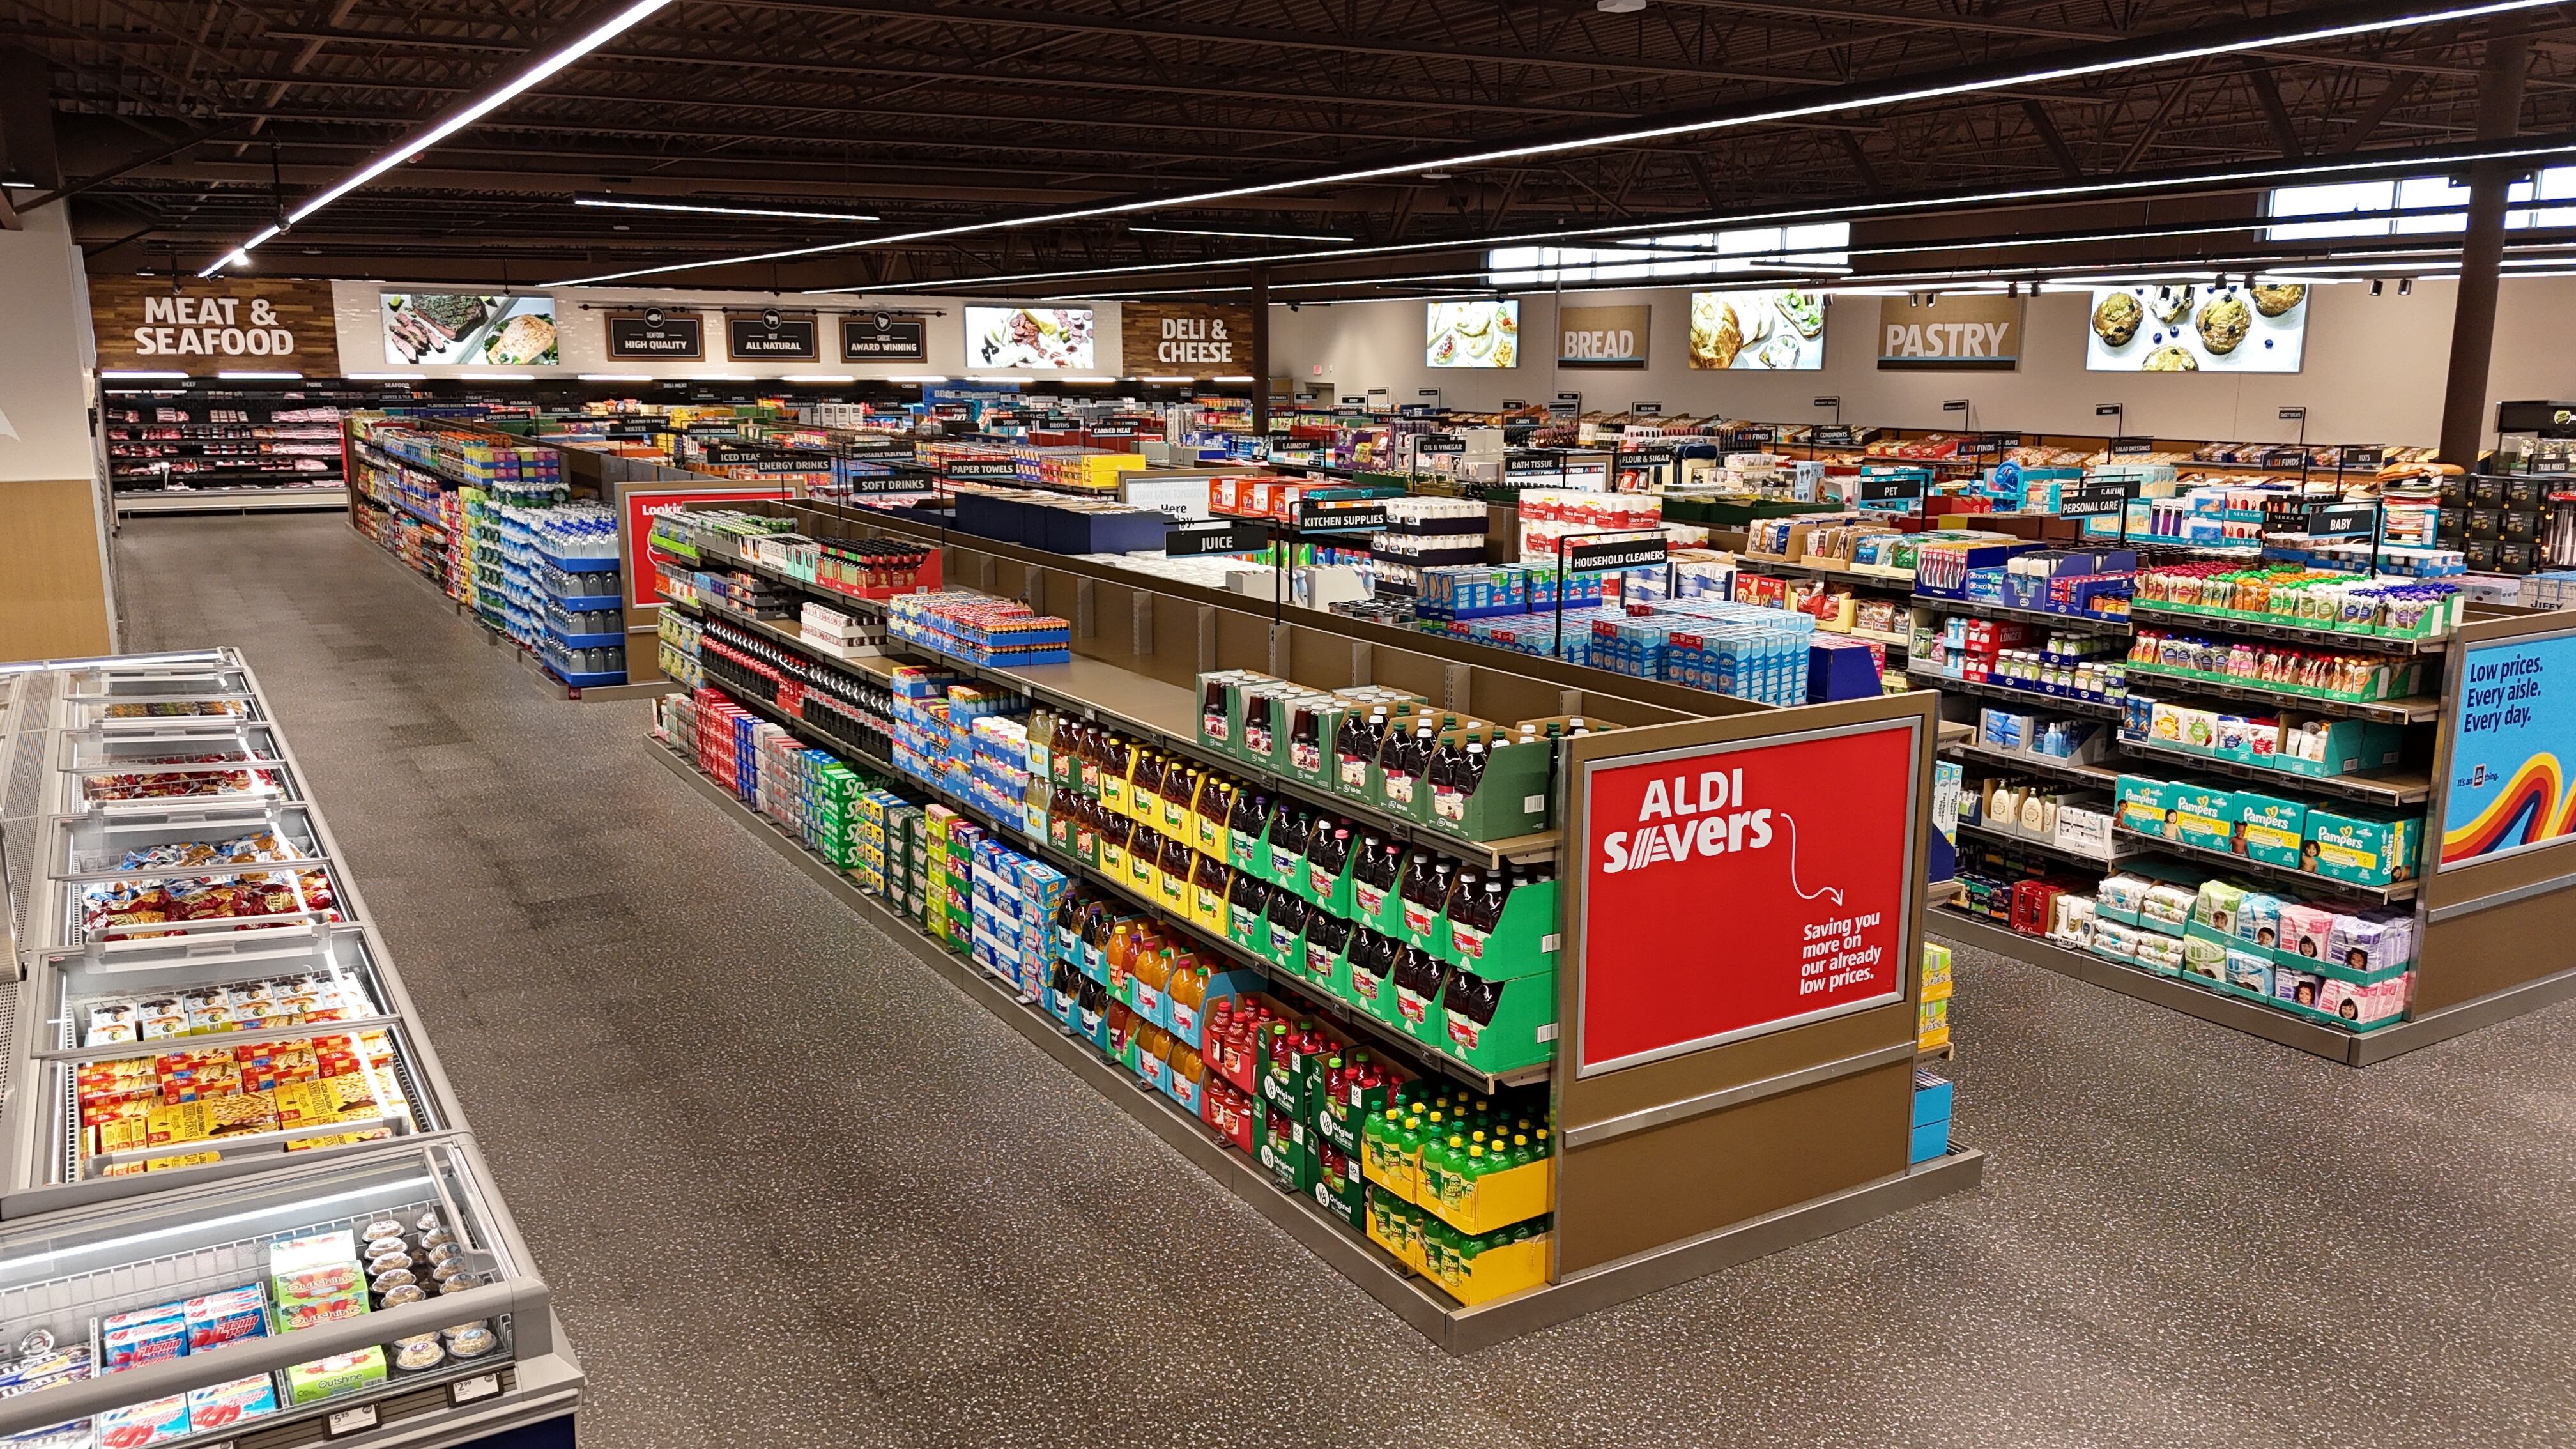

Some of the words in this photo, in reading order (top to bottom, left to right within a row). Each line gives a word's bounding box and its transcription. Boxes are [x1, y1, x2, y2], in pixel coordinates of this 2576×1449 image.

[145, 297, 238, 326] MEAT
[250, 298, 277, 325] &
[1162, 319, 1205, 339] DELI
[1211, 319, 1227, 339] &
[134, 327, 294, 355] SEAFOOD
[625, 340, 648, 349] HIGH
[649, 340, 687, 351] QUALITY
[746, 342, 762, 350] ALL
[763, 341, 801, 351] NATURAL
[851, 342, 880, 351] AWARD
[882, 343, 917, 352] WINNING
[1564, 330, 1634, 359] BREAD
[1885, 322, 2009, 358] PASTRY
[1158, 342, 1232, 363] CHEESE
[1752, 432, 1769, 440] FINDS
[1820, 431, 1848, 439] CONDIMENTS
[1282, 441, 1310, 450] LAUNDRY
[1960, 444, 1975, 454] ALDI
[1977, 443, 1995, 452] FINDS
[740, 453, 760, 461] TEAS
[759, 461, 793, 470] ENERGY
[795, 460, 829, 470] DRINKS
[1512, 461, 1529, 469] BATH
[1531, 460, 1553, 468] TISSUE
[1622, 456, 1642, 464] FLOUR
[1649, 454, 1670, 463] SUGAR
[2266, 459, 2281, 468] ALDI
[2281, 457, 2299, 466] FINDS
[952, 464, 979, 474] PAPER
[981, 463, 1013, 473] TOWELS
[862, 481, 885, 490] SOFT
[887, 480, 924, 489] DRINKS
[1884, 486, 1898, 496] PET
[2062, 502, 2096, 514] PERSONAL
[2098, 500, 2118, 511] CARE
[1304, 517, 1341, 527] KITCHEN
[1343, 514, 1384, 526] SUPPLIES
[2330, 518, 2352, 531] BABY
[1200, 536, 1233, 552] JUICE
[1574, 554, 1624, 568] HOUSEHOLD
[1625, 550, 1665, 564] CLEANERS
[2530, 599, 2563, 610] JIFFY
[2000, 631, 2022, 642] LONGER
[2470, 663, 2498, 683] Low
[2499, 654, 2543, 684] prices.
[2467, 686, 2506, 709] Every
[2507, 677, 2542, 702] aisle.
[2464, 711, 2502, 733] Every
[2504, 704, 2532, 728] day.
[2457, 778, 2465, 787] It's
[2485, 772, 2499, 781] thing.
[1639, 768, 1743, 822] ALDI
[2126, 788, 2158, 806] Pampers
[2178, 796, 2218, 818] Pampers
[2183, 815, 2210, 824] swaddlers
[2243, 806, 2289, 830] Pampers
[2250, 827, 2279, 837] swaddlers
[2318, 826, 2363, 850] Pampers
[2287, 837, 2293, 845] 5
[2325, 846, 2354, 856] swaddlers
[2382, 833, 2394, 875] Pampers
[2362, 857, 2368, 865] 6
[1804, 919, 1851, 941] Saving
[1855, 912, 1880, 930] you
[1802, 938, 1840, 959] more
[1843, 934, 1862, 949] on
[1801, 959, 1826, 977] our
[1829, 946, 1882, 972] already
[1800, 977, 1825, 995] low
[1829, 966, 1874, 993] prices.
[1266, 1080, 1275, 1096] V8
[1276, 1085, 1296, 1105] Original
[1352, 1088, 1360, 1098] 46
[1322, 1115, 1331, 1131] V8
[1332, 1121, 1354, 1141] Original
[1294, 1126, 1301, 1137] 46
[1264, 1149, 1272, 1165] V8
[1274, 1155, 1295, 1175] Original
[1349, 1163, 1357, 1174] 46
[1318, 1186, 1328, 1204] V8
[1329, 1193, 1352, 1214] Original
[287, 1273, 358, 1293] Outshine
[289, 1307, 362, 1328] Outshine
[318, 1372, 363, 1390] Outshine
